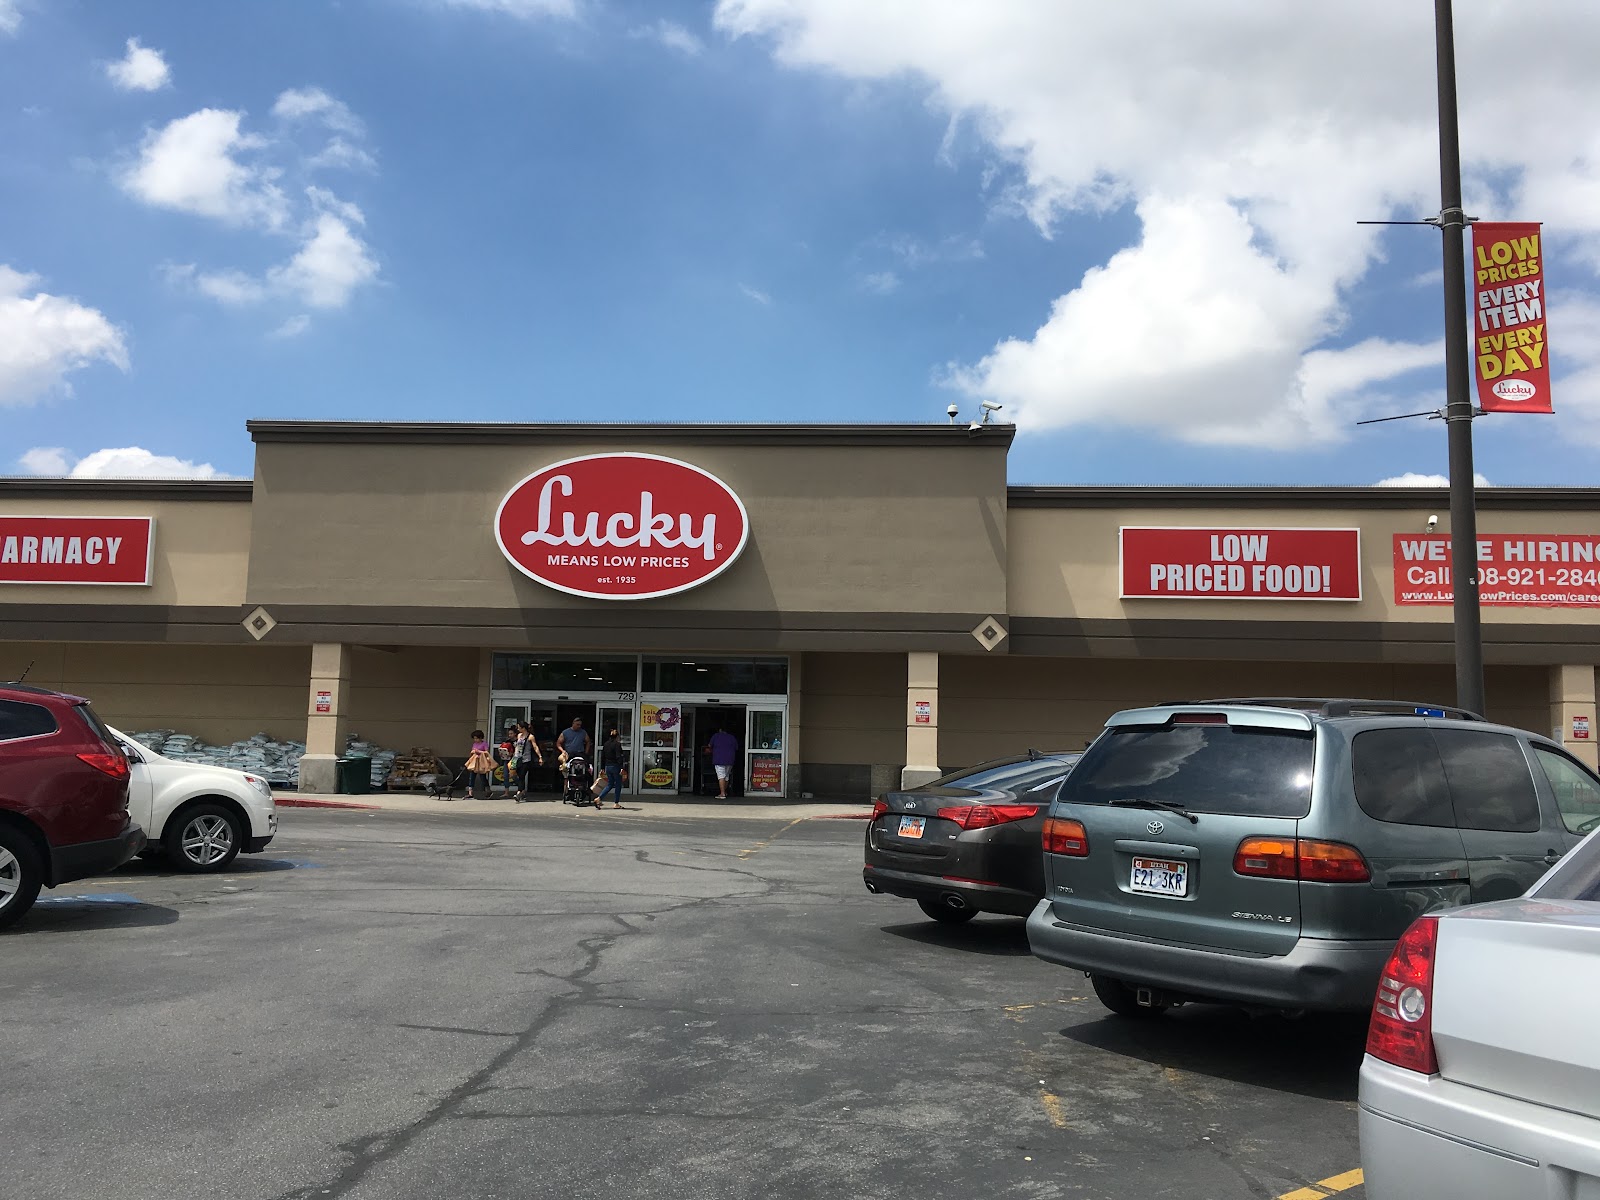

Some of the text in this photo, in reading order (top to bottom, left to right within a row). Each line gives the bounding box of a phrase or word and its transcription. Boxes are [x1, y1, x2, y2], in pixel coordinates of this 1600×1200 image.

[1476, 235, 1539, 268] LOW
[1477, 260, 1539, 285] PRICES
[1478, 280, 1541, 309] EVERY
[1479, 298, 1542, 331] ITEM
[1478, 324, 1544, 355] EVERY
[1478, 341, 1545, 380] DAY
[1497, 382, 1532, 396] Lucky
[520, 474, 717, 561] Lucky
[0, 536, 122, 565] ARMACY
[1210, 534, 1268, 562] LOW
[1400, 541, 1600, 563] WE'E HIRIN
[547, 555, 690, 568] MEANS LOW PRICES
[615, 576, 637, 584] 1935
[1150, 563, 1331, 593] PRICED FOOD!
[1407, 566, 1450, 585] Call
[617, 692, 635, 701] 729
[1150, 861, 1169, 869] UTAH
[1134, 868, 1183, 890] E21 3KR
[1231, 911, 1293, 923] SIENNA LE
